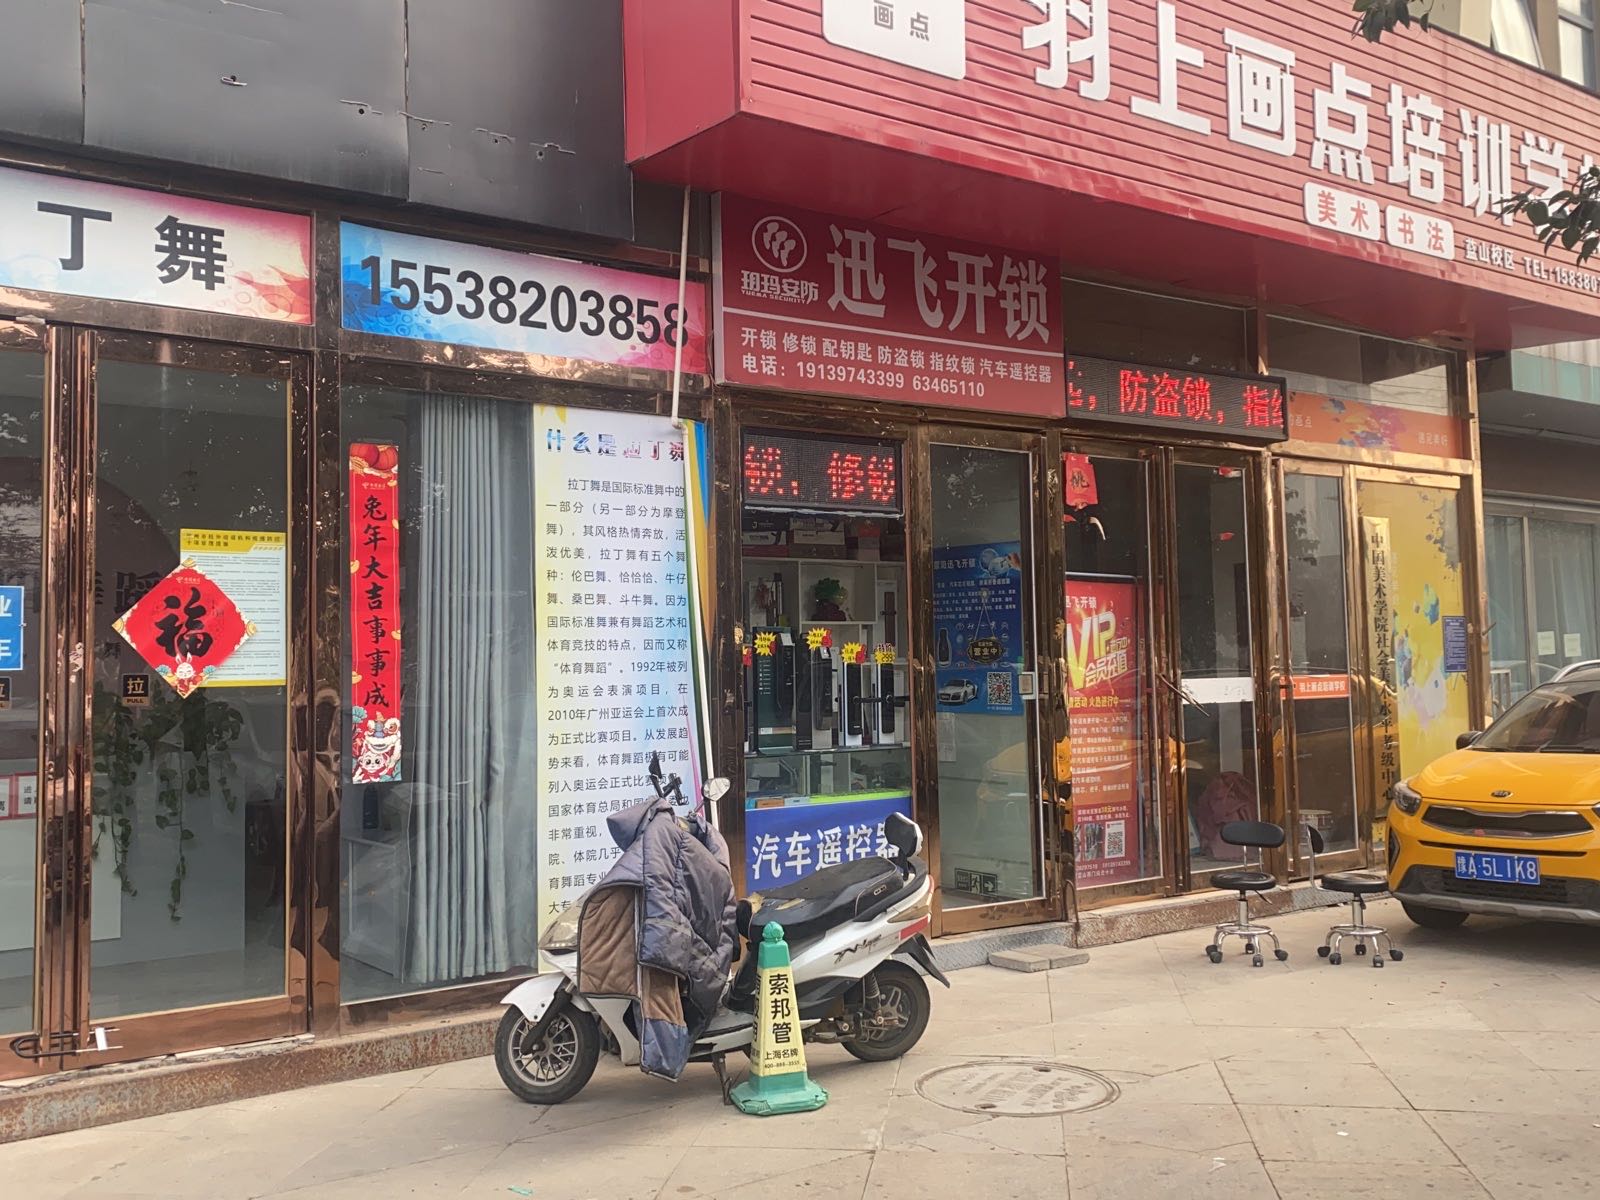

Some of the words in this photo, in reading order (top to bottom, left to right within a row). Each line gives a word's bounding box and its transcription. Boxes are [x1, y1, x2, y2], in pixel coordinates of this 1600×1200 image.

[873, 0, 930, 41] 画点
[1021, 0, 1600, 252] 羽上画点培训学
[1318, 190, 1369, 232] 美术
[1397, 213, 1444, 254] 书法
[37, 201, 228, 291] 丁舞
[741, 270, 819, 304] 玥玛安防
[826, 223, 1050, 344] 迅飞开锁
[361, 255, 689, 347] 15538203858
[741, 290, 767, 299] YUEMA
[770, 294, 806, 305] SECURITY
[741, 327, 777, 350] 开锁
[782, 332, 817, 356] 修锁
[822, 338, 872, 362] 配钥匙
[878, 345, 925, 369] 防盗锁
[930, 352, 975, 375] 指纹锁
[980, 358, 1052, 383] 汽车遥控器
[797, 361, 904, 388] 19139743399
[912, 375, 984, 397] 63465110
[567, 478, 685, 498] 拉丁舞是国际标准舞中的
[546, 547, 686, 563] 泼优美，拉丁舞有五个舞
[361, 495, 390, 708] 兔年大吉事事成
[546, 593, 687, 607] 舞、桑巴舞、斗牛舞。因为
[154, 586, 214, 658] 福
[547, 616, 688, 629] 国际标准舞兼有舞蹈艺术和
[547, 639, 688, 652] 体育竞技的特点，因而又称
[973, 647, 998, 657] 营业中
[1066, 611, 1116, 690] VIP
[126, 678, 145, 696] 拉
[548, 683, 689, 698] 为奥运会表演项目，在
[548, 705, 689, 721] 2010年广州亚运会上首次成
[548, 728, 690, 746] 为正式比赛项目。从发展趋
[548, 773, 678, 794] 列入奥运会正式比项
[766, 973, 793, 1044] 索邦管
[764, 1048, 799, 1061] 上海名牌
